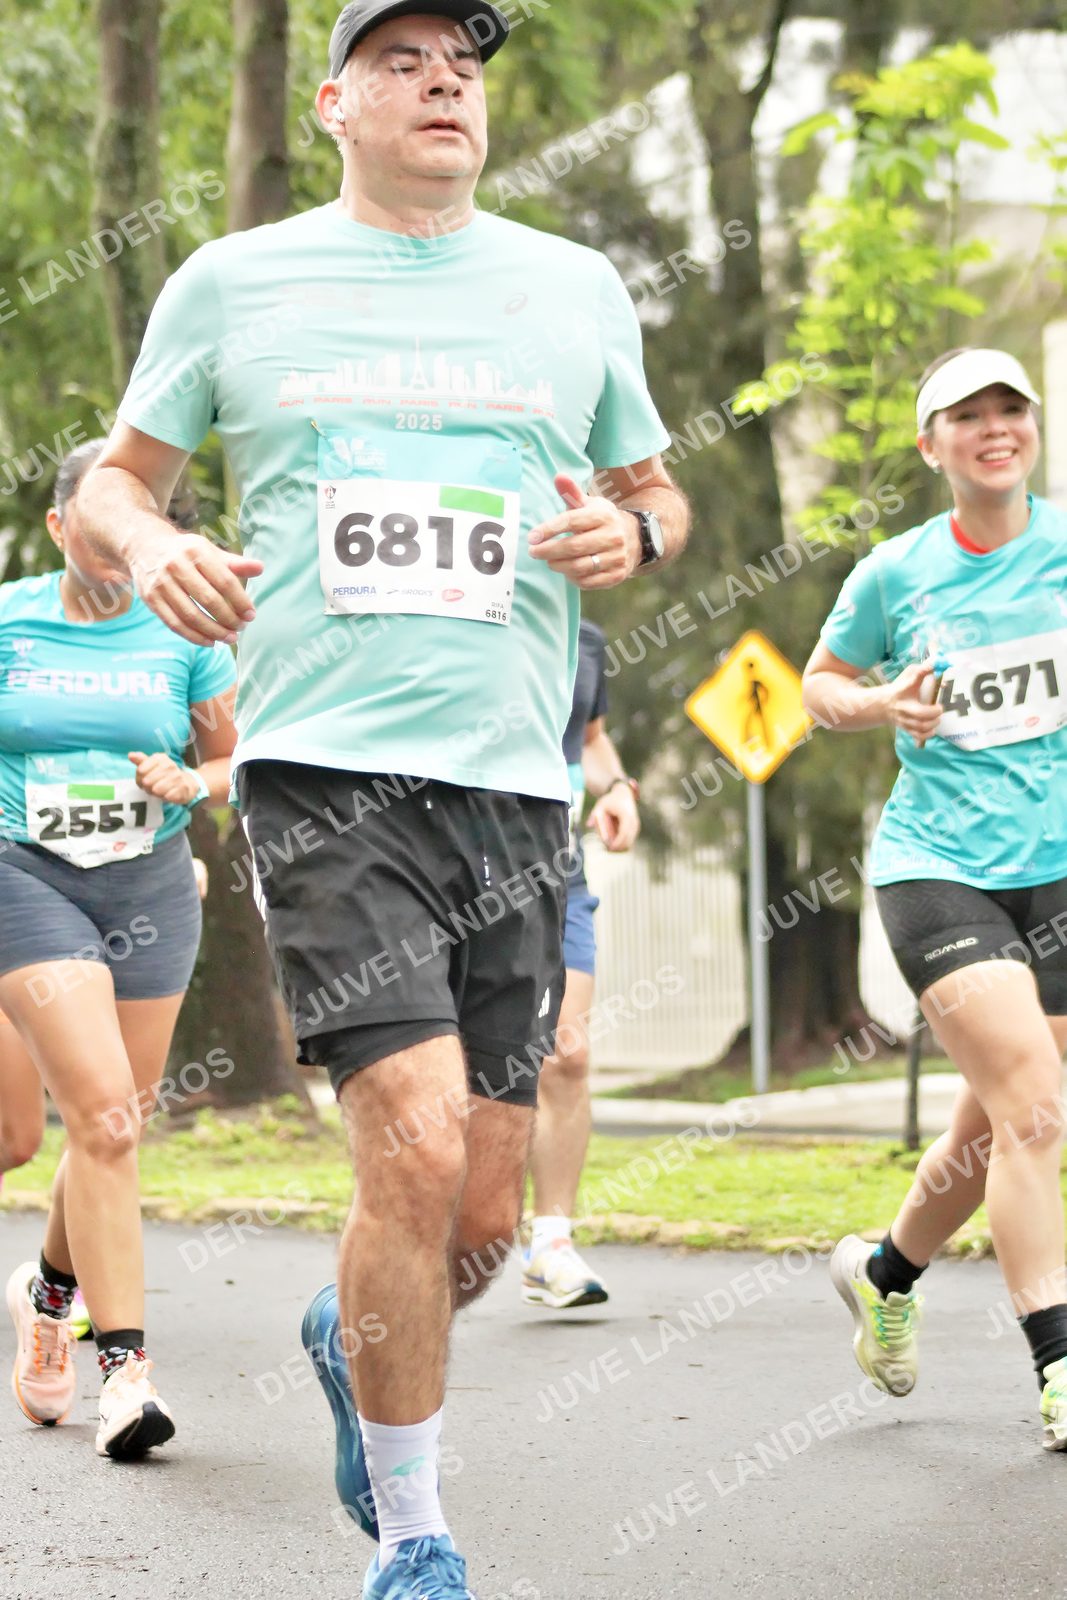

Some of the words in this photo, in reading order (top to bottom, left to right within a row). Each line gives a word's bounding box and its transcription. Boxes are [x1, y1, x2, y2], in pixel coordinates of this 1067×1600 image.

[395, 412, 443, 431] 2025
[334, 512, 506, 576] 6816
[333, 586, 377, 597] PERDURA
[485, 609, 507, 621] 6816
[7, 669, 172, 696] PERDURA
[939, 659, 1060, 718] 4671
[37, 801, 147, 841] 2551
